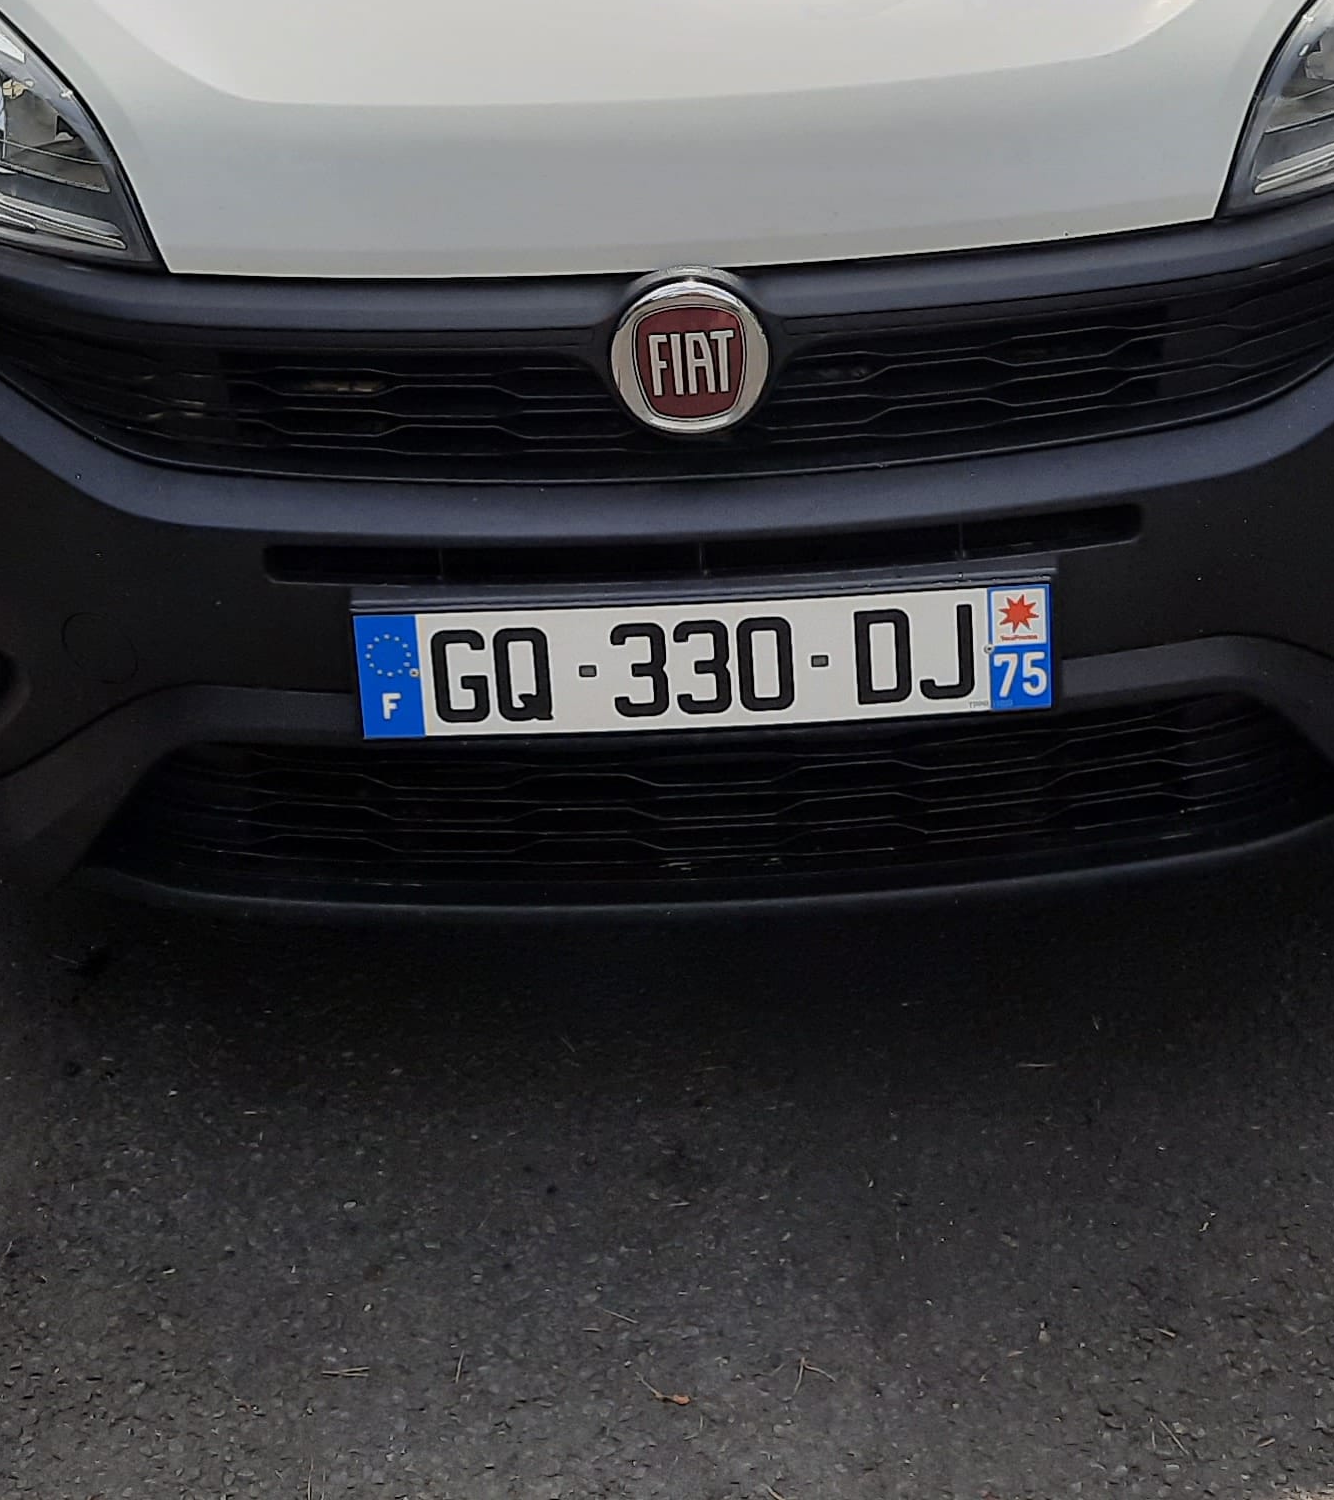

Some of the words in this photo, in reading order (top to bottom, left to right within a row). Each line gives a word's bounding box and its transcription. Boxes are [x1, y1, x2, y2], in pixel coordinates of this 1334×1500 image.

[648, 329, 735, 396] FIAT
[993, 651, 1047, 698] 75
[382, 692, 402, 720] F
